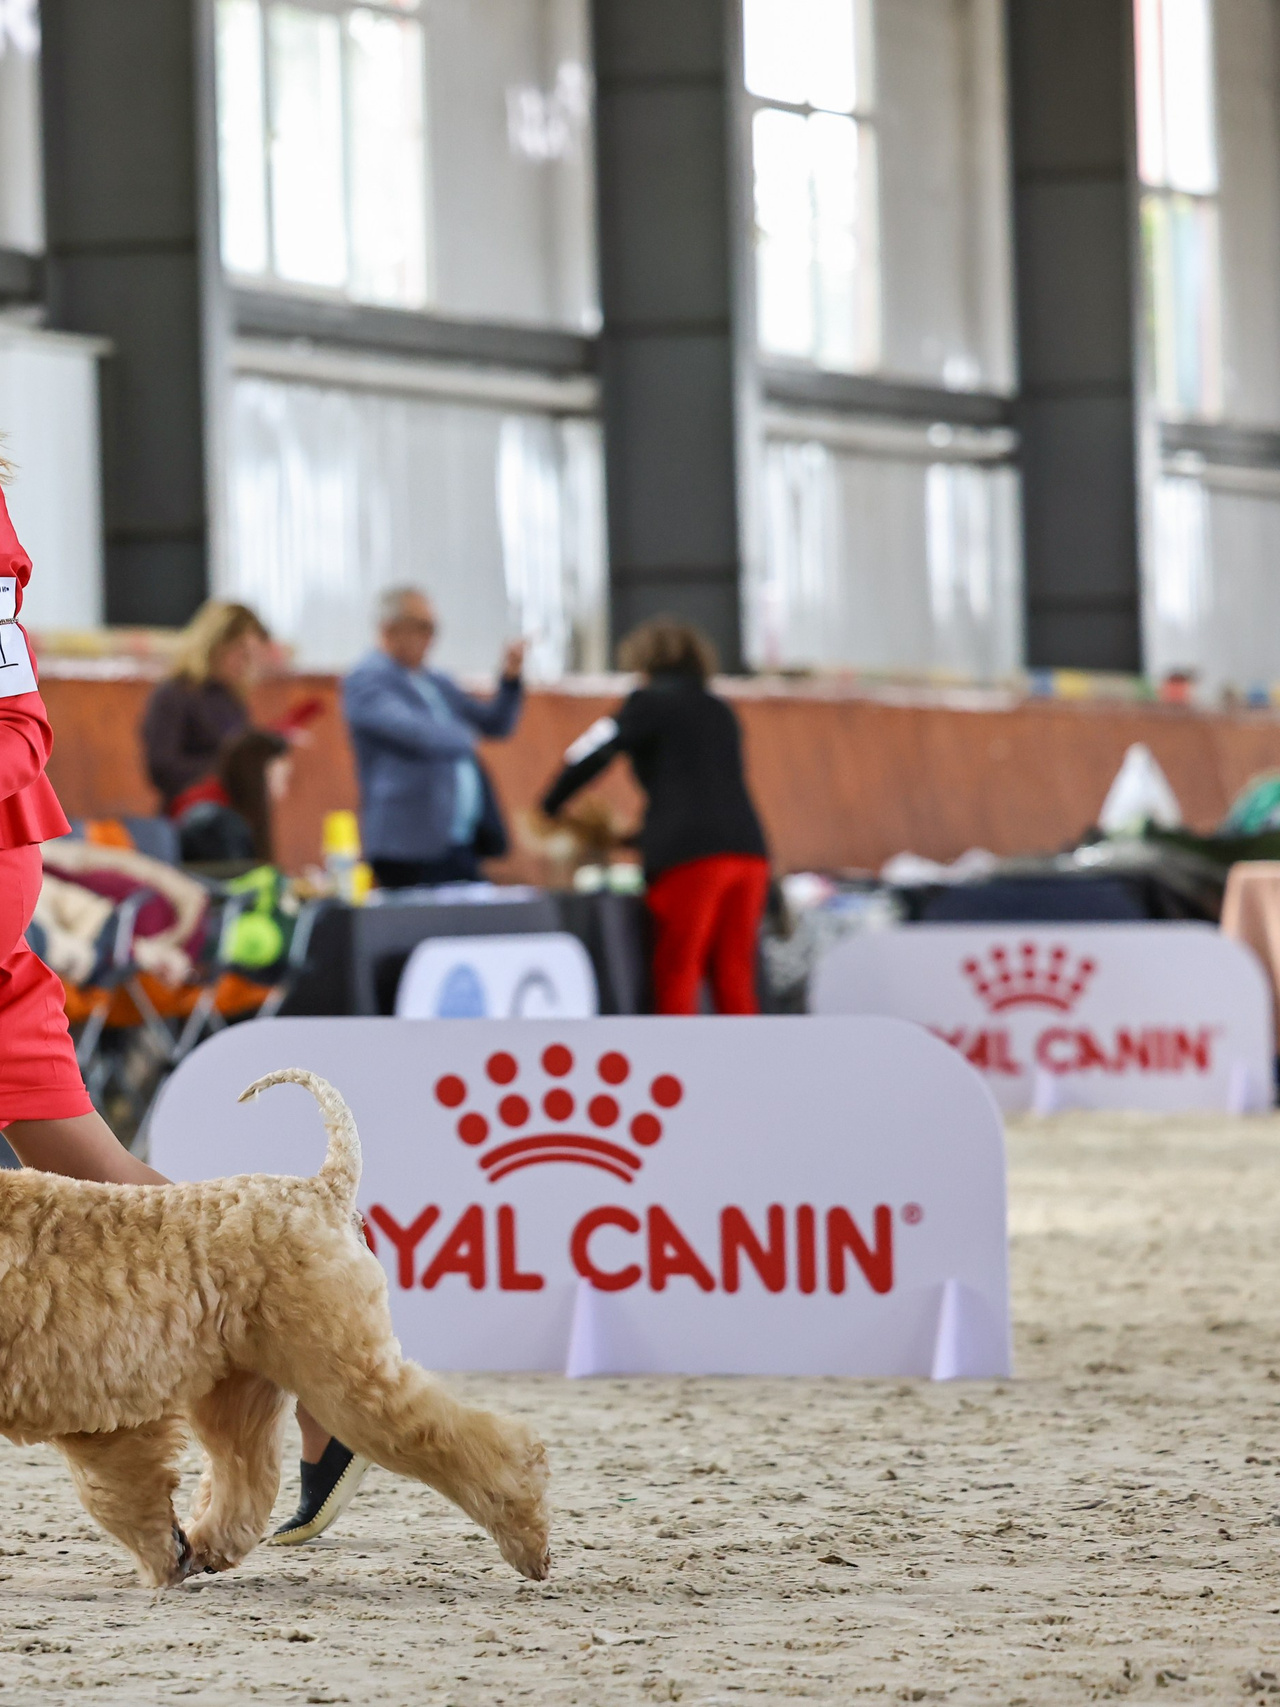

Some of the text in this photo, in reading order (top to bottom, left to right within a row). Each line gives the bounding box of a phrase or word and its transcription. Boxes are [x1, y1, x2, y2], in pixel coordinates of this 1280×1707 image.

[1034, 1024, 1213, 1076] CANIN
[361, 1203, 894, 1294] YAL CANIN
